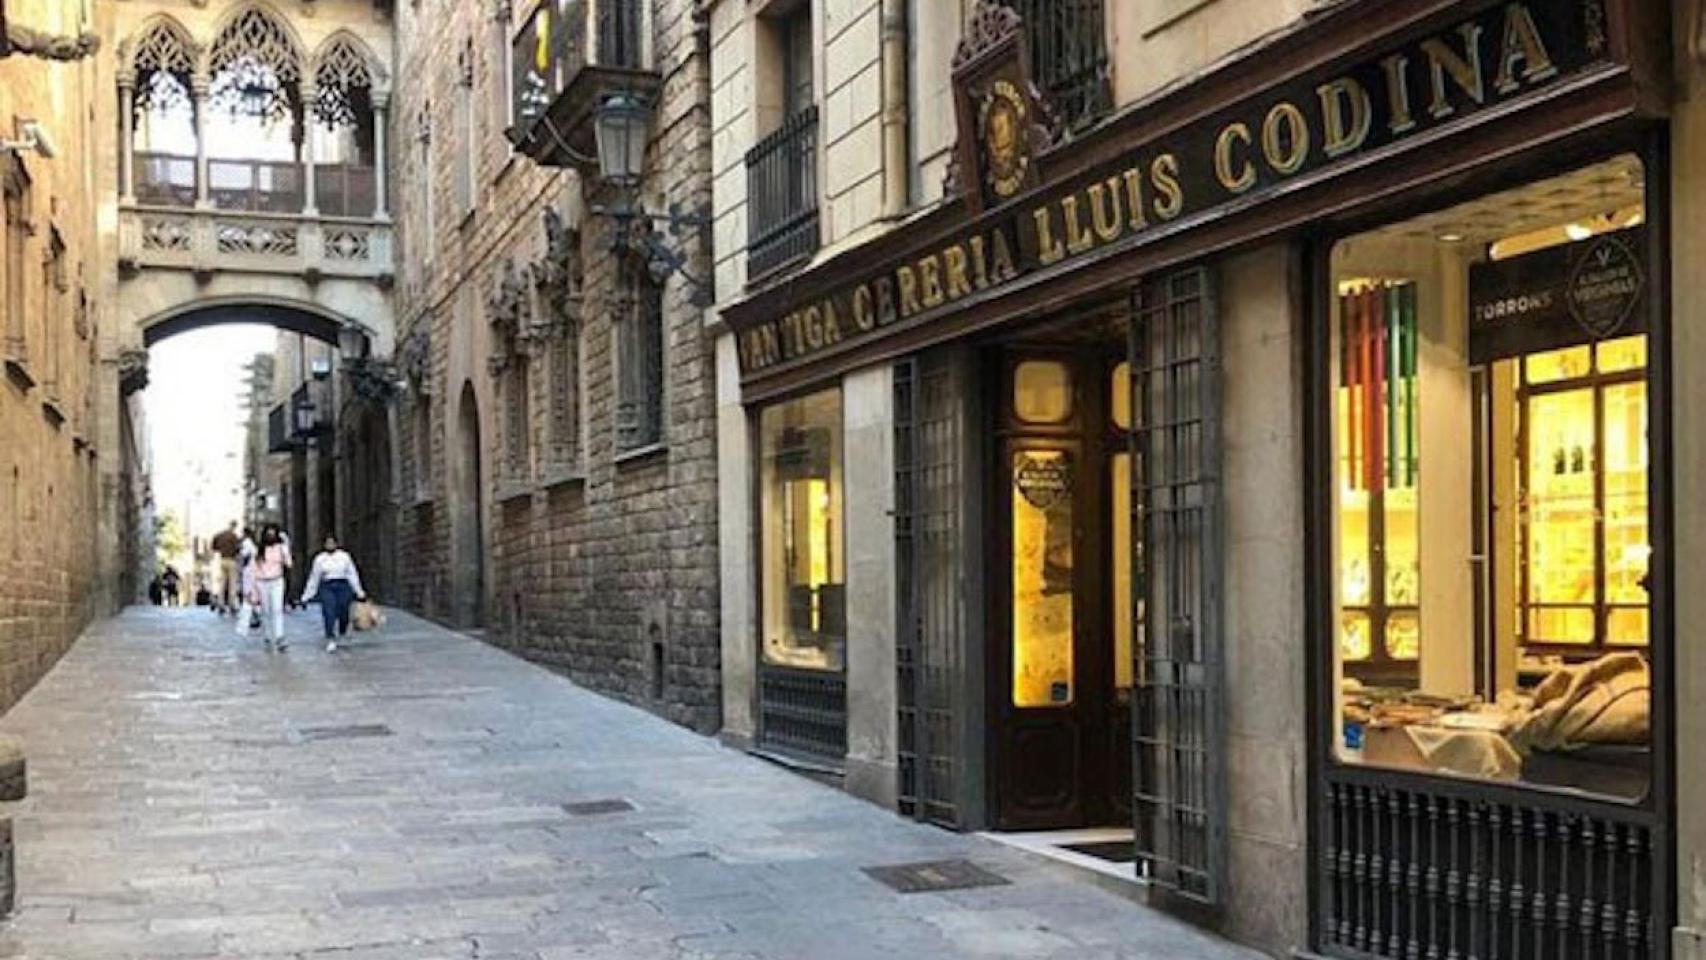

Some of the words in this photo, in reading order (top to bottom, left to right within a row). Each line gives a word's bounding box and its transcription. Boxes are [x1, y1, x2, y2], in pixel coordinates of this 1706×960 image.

[853, 227, 1021, 330] CERERIA
[1033, 152, 1183, 263] LLUIS
[1213, 2, 1558, 194] CODINA
[1475, 291, 1553, 321] TORRONS
